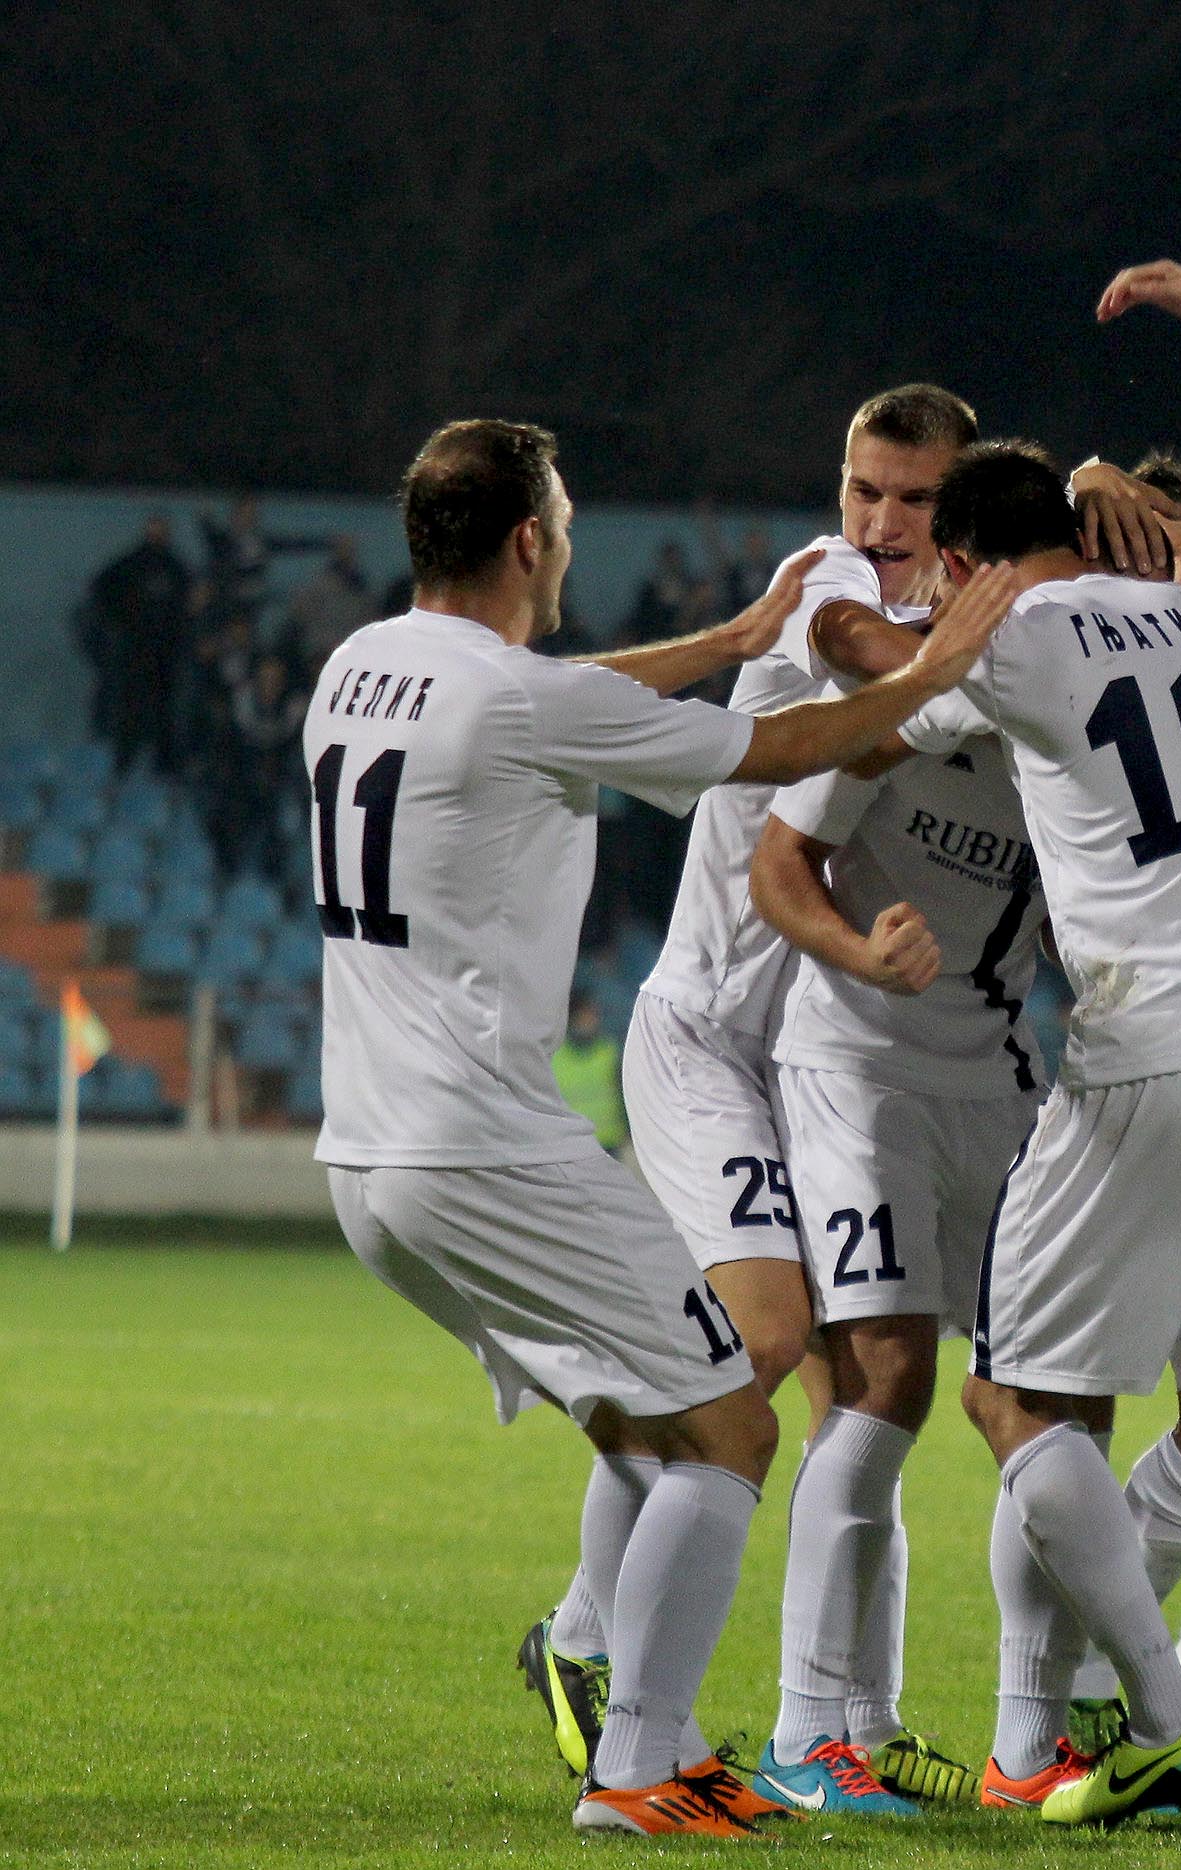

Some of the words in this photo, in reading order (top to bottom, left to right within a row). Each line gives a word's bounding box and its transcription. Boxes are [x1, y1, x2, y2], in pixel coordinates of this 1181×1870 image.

[313, 743, 410, 949] 11
[722, 1156, 799, 1230] 25
[826, 1203, 906, 1288] 21
